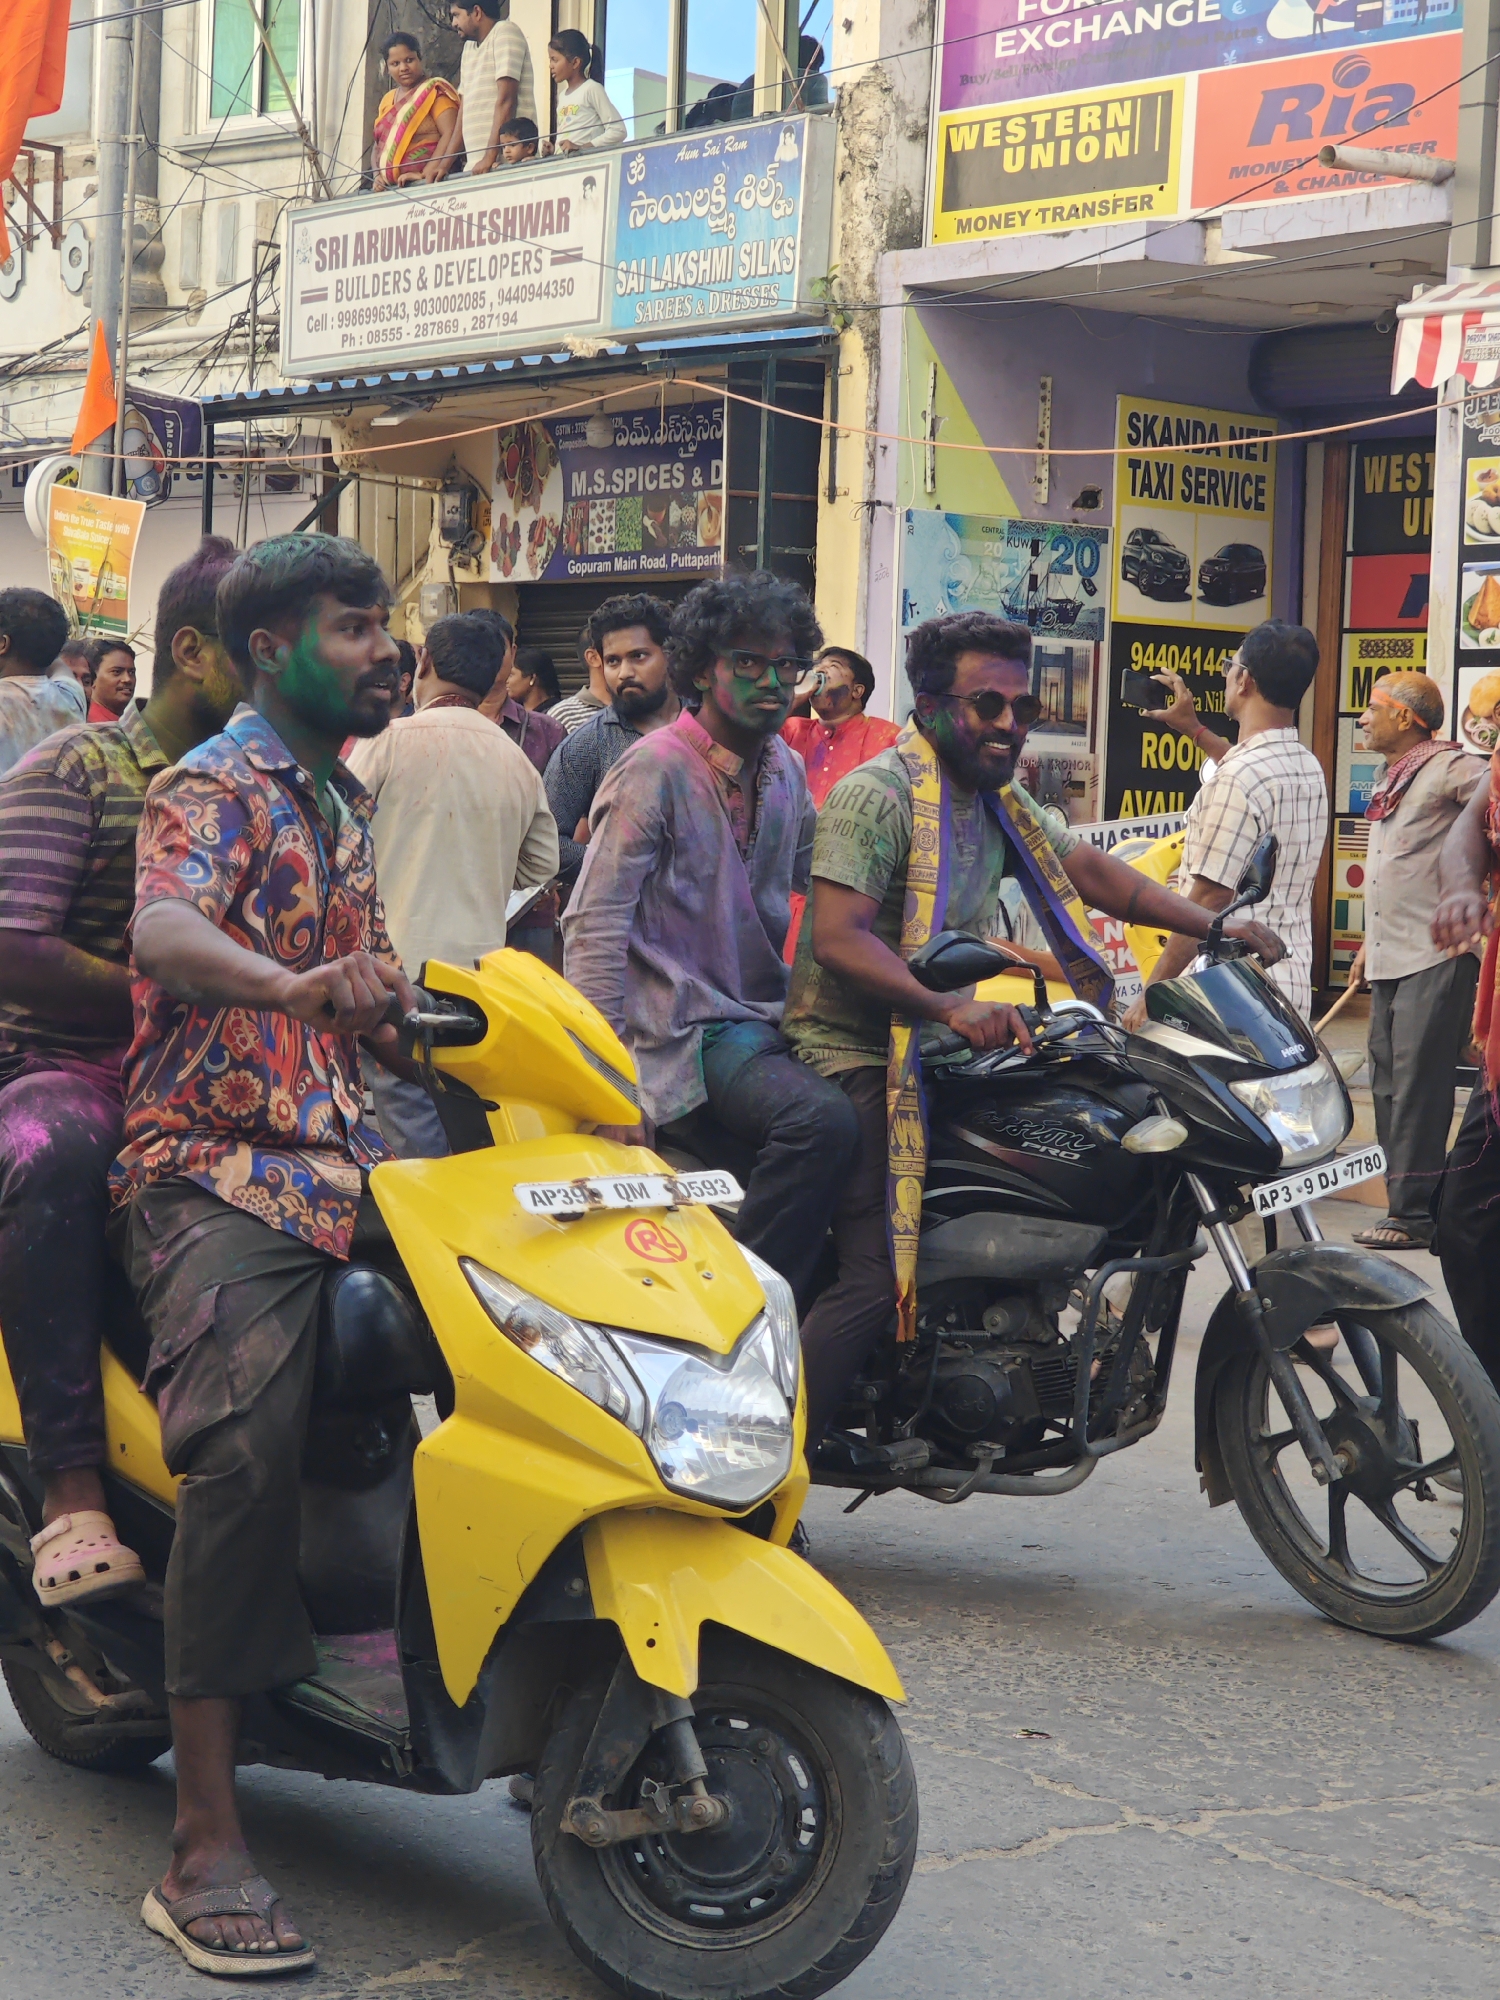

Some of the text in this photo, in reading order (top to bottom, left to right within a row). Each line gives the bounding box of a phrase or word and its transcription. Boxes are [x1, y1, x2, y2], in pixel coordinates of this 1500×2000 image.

[994, 0, 1222, 58] EXCHANGE
[1247, 54, 1416, 148] Ria
[948, 100, 1132, 153] WESTERN
[675, 136, 748, 163] Aum Sai Ram
[1003, 129, 1131, 174] UNION
[1228, 156, 1312, 180] MONEY
[1273, 172, 1386, 194] & CHANGE
[447, 197, 468, 213] Ram
[956, 194, 1154, 235] MONEY TRANSFER
[315, 197, 571, 273] SRI ARUNACHALESHWAR
[335, 248, 543, 303] BUILDERS & DEVELOPERS
[616, 236, 795, 297] SAI LAKSHMI SILKS
[635, 283, 780, 324] SAREES & DRESSES
[307, 314, 328, 334] Cell
[341, 332, 356, 349] Ph
[367, 326, 403, 345] 08555
[414, 318, 459, 339] 287869
[471, 310, 518, 332] 287194
[1127, 411, 1273, 463] SKANDA NET
[571, 463, 685, 497] M.S.SPICES
[691, 469, 703, 487] &
[1128, 458, 1266, 512] TAXI SERVICE
[80, 515, 94, 528] True
[95, 518, 114, 532] Taste
[115, 523, 131, 535] with
[567, 559, 611, 577] Gopuram
[614, 556, 637, 572] Main
[640, 553, 668, 571] Road,
[1049, 535, 1100, 579] 20
[830, 818, 861, 840] HOT
[1281, 1043, 1306, 1058] Hero
[1021, 1141, 1081, 1160] PRO
[1318, 1168, 1339, 1190] DJ
[1346, 1152, 1382, 1179] 7780
[529, 1185, 587, 1207] AP39
[613, 1182, 651, 1201] QM
